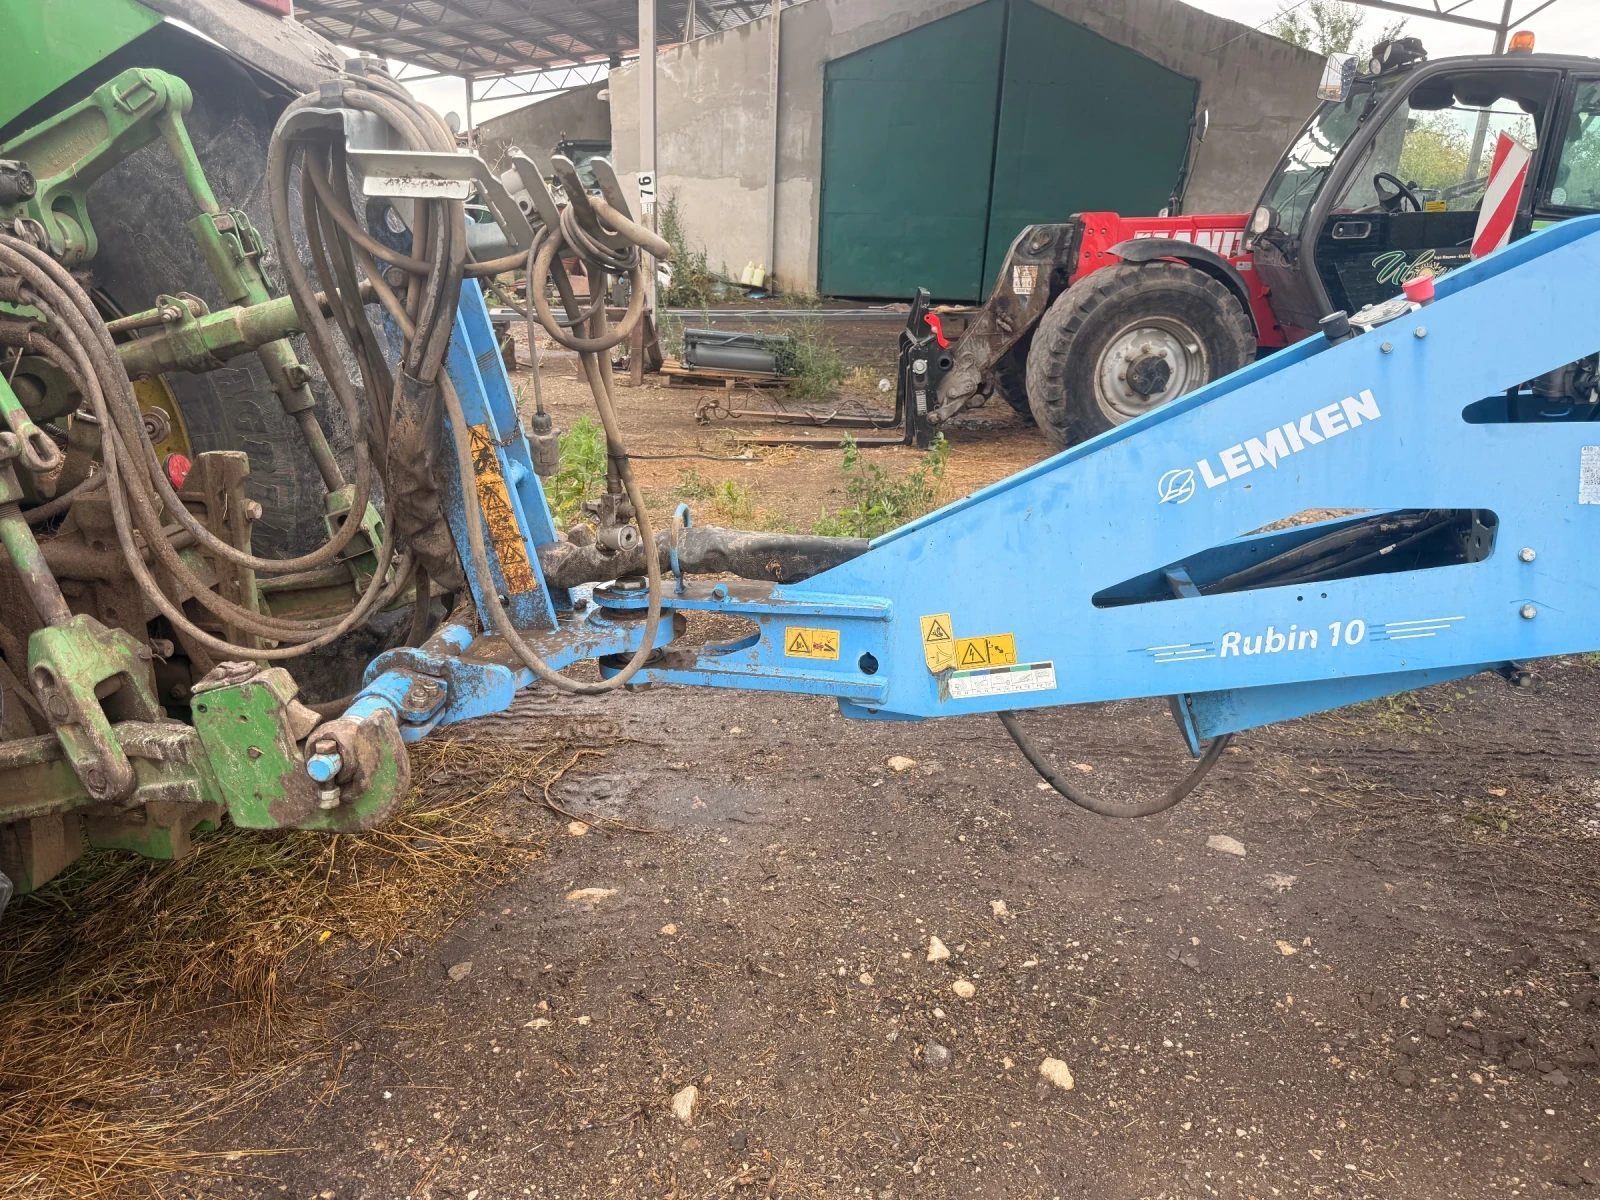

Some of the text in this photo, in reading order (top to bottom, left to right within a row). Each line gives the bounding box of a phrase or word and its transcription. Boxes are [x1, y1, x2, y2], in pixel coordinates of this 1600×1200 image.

[638, 176, 654, 198] 76
[1197, 388, 1382, 489] LEMKEN
[1220, 619, 1366, 658] Rubin 10
